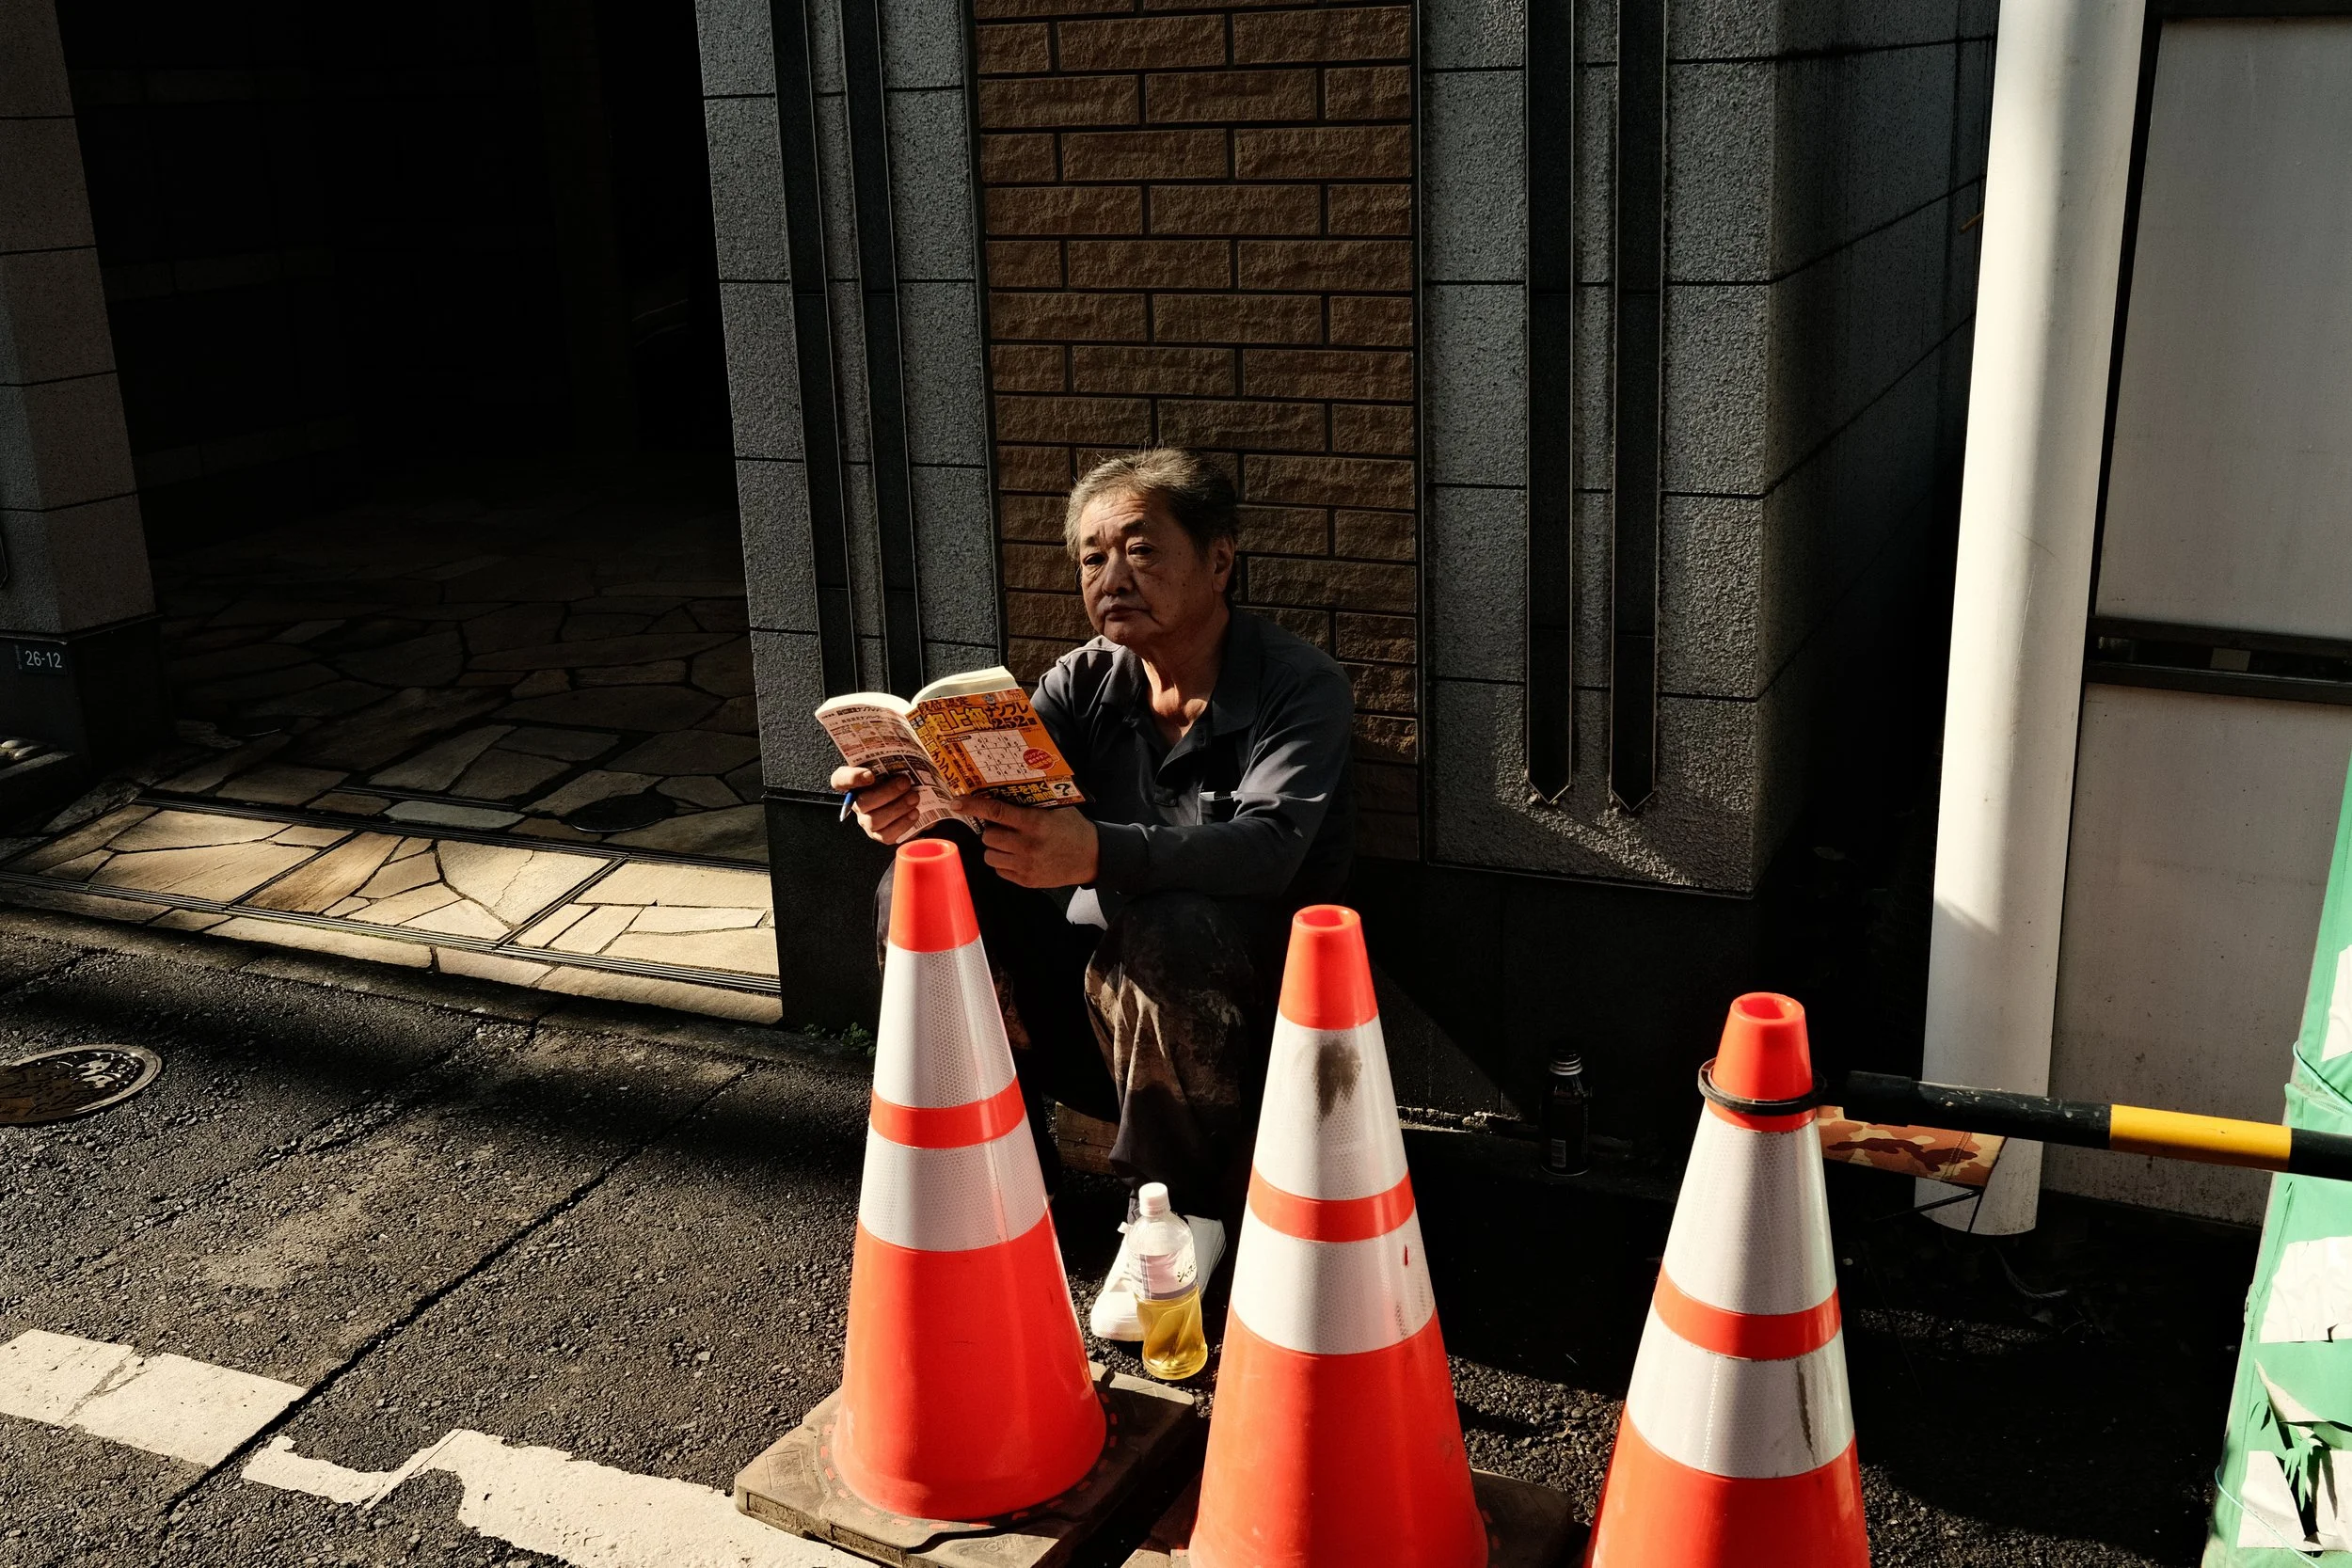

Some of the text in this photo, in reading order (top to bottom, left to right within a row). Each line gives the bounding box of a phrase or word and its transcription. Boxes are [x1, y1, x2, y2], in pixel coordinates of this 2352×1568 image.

[25, 650, 62, 668] 26-12
[925, 706, 994, 736] 超上級
[985, 702, 1028, 717] ナンプレ
[1054, 783, 1071, 797] ?
